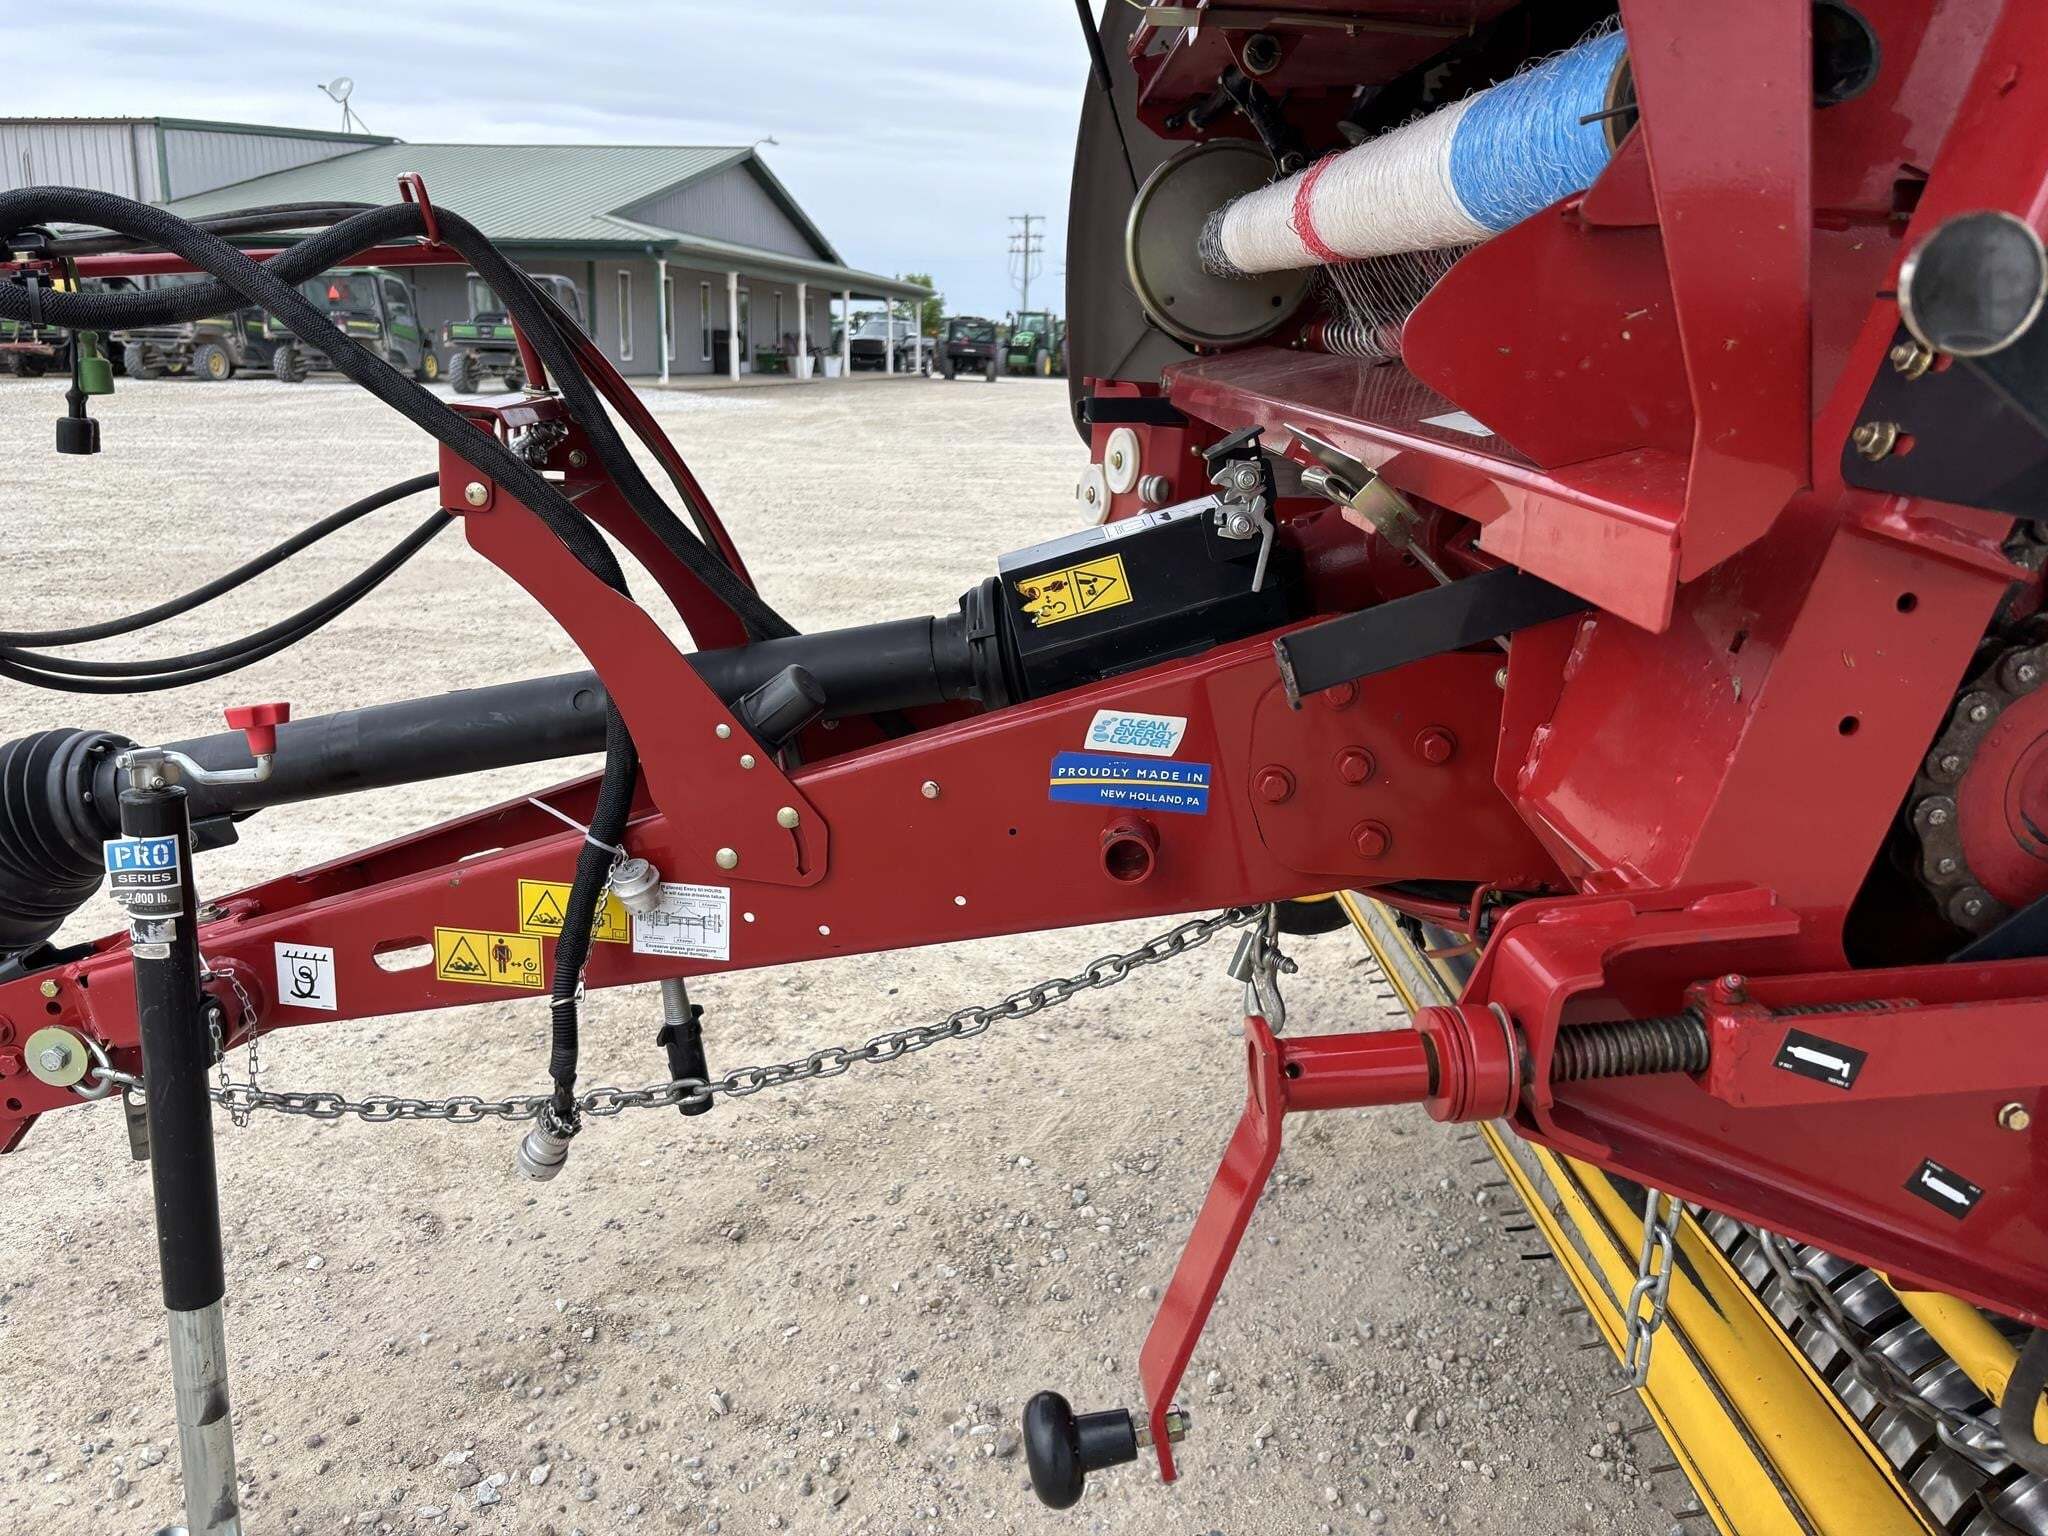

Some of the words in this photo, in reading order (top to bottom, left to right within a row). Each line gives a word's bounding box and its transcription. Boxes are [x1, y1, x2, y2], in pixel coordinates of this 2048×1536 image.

[1119, 718, 1170, 731] CLEAN
[1113, 726, 1177, 740] ENERGY
[1109, 735, 1170, 748] LEADER
[1058, 767, 1130, 777] PROUDLY
[1136, 769, 1180, 781] MADE
[1186, 772, 1204, 782] IN
[1100, 789, 1127, 799] NEW
[1129, 792, 1184, 806] HOLLAND,
[1186, 797, 1200, 806] PA
[117, 872, 172, 884] SERIES
[157, 892, 171, 904] lb.
